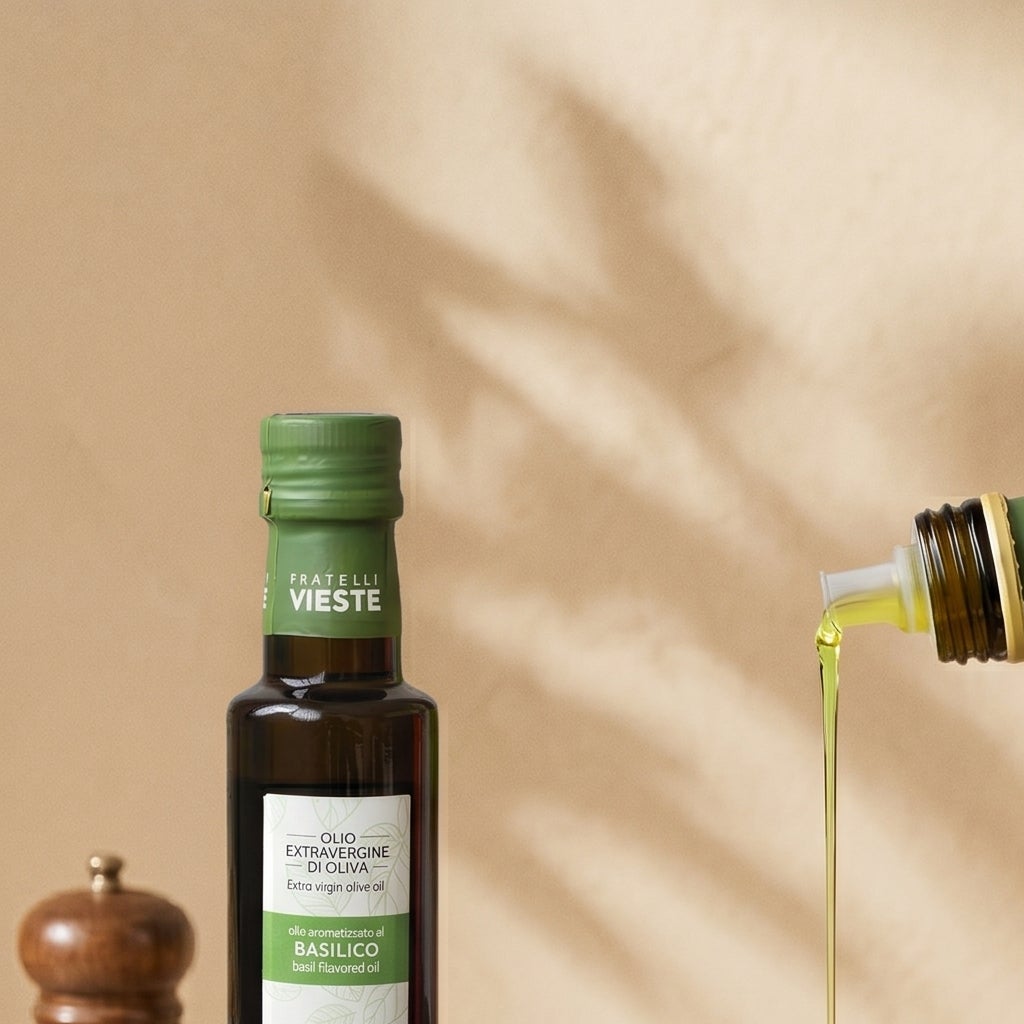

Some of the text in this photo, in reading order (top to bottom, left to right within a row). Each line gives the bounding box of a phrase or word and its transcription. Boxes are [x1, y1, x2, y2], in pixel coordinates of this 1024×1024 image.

[290, 573, 378, 587] FRATELLI
[289, 588, 382, 613] VIESTE
[320, 832, 356, 844] OLIO
[286, 844, 390, 859] EXTRAVERGINE
[307, 861, 369, 874] DI OLIVA
[287, 879, 385, 895] Extra virgin olive oil
[294, 941, 379, 958] BASILICO
[292, 960, 315, 973] basil
[367, 961, 380, 973] oil
